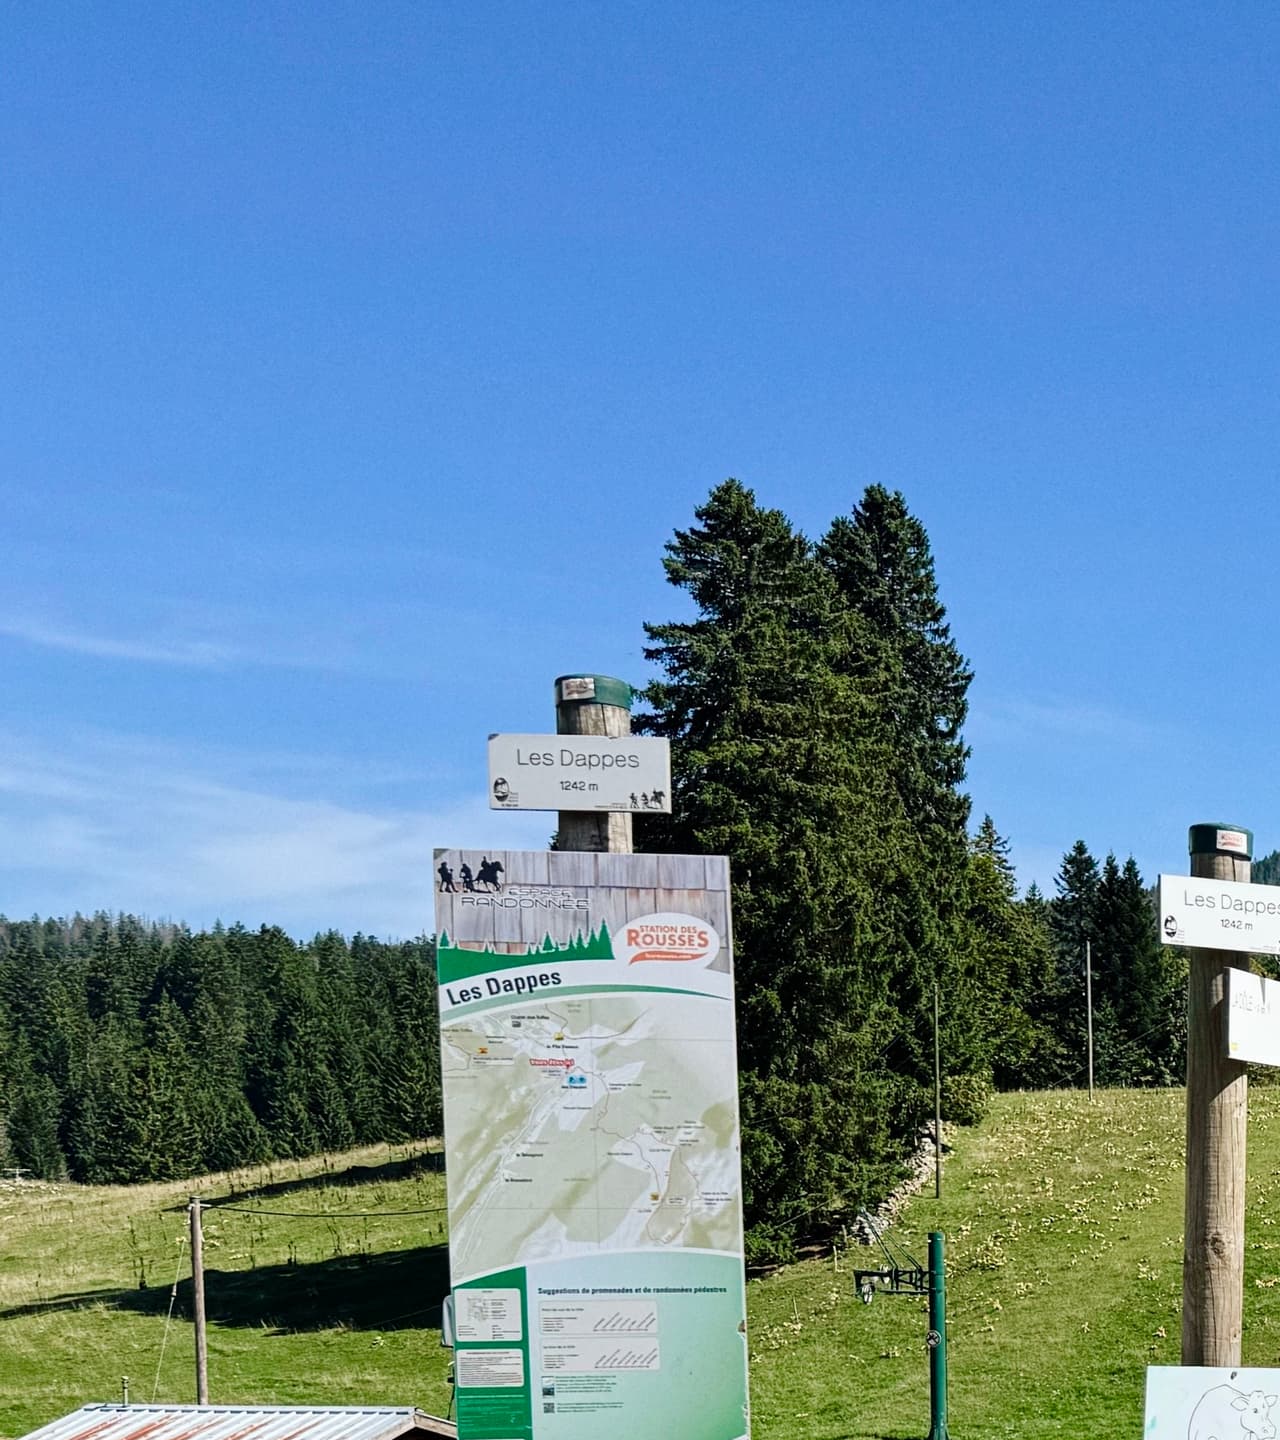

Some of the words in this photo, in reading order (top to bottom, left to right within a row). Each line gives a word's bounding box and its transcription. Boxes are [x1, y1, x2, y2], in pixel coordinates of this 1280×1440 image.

[516, 748, 554, 766] Les
[560, 749, 640, 771] Dappes
[560, 780, 586, 791] 1242
[588, 783, 598, 791] m
[508, 887, 571, 897] ESPACE
[1184, 889, 1216, 909] Les
[639, 925, 678, 933] STATION
[680, 926, 697, 934] DES
[1220, 919, 1242, 930] 1242
[1244, 923, 1253, 931] m
[626, 928, 709, 948] ROUSSES
[446, 987, 483, 1006] Les
[485, 971, 562, 995] Dappes
